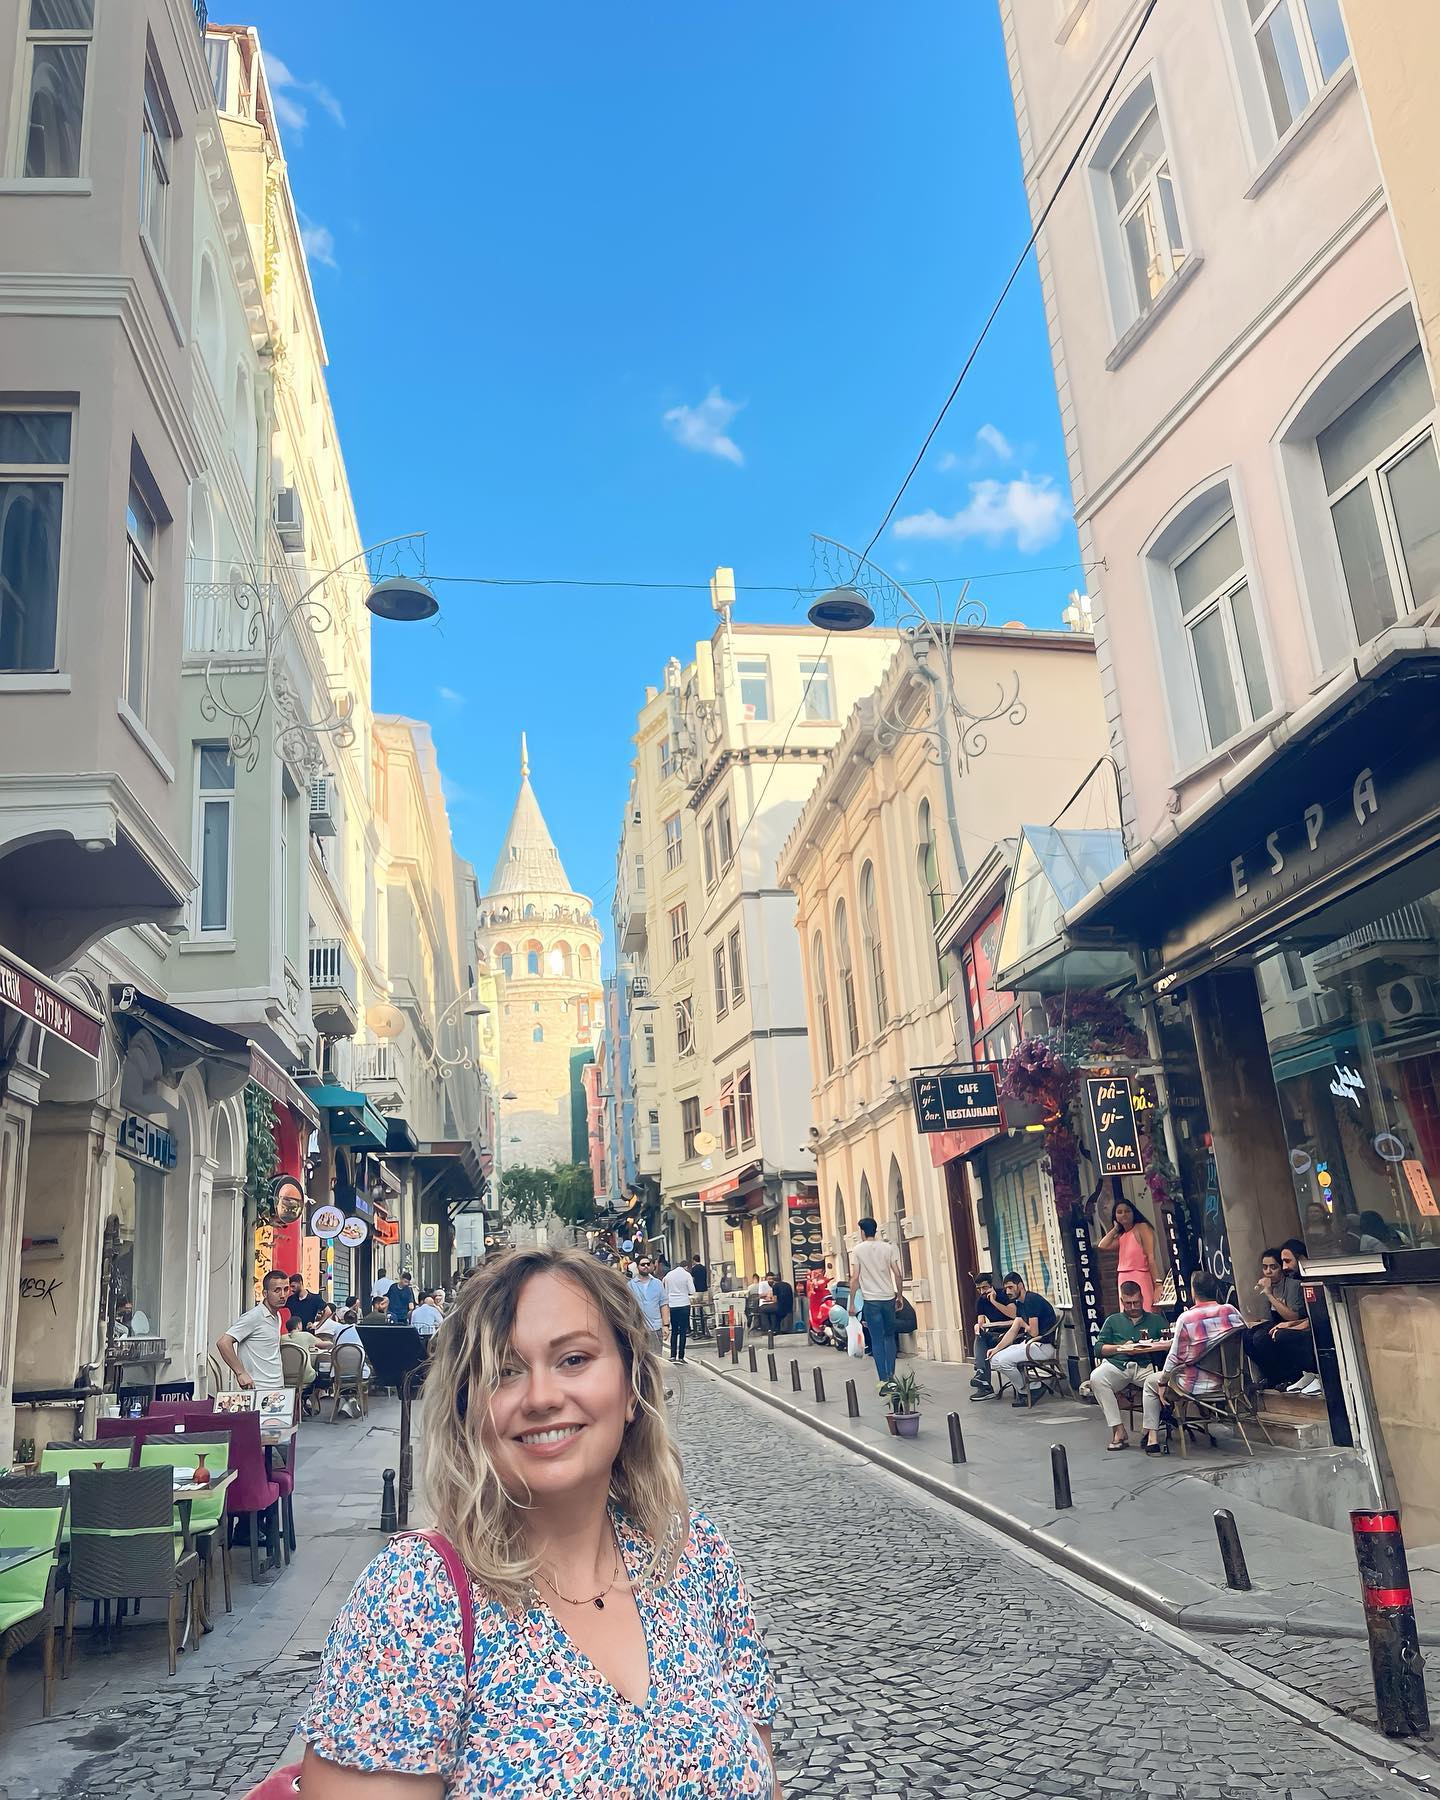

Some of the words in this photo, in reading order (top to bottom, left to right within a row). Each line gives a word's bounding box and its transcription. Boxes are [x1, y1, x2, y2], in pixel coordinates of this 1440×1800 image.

[1231, 767, 1378, 899] ESPA
[957, 1083, 979, 1094] CAFE
[967, 1095, 974, 1105] &
[946, 1106, 998, 1120] RESTAURANT
[1075, 1228, 1100, 1347] RESTAURAN
